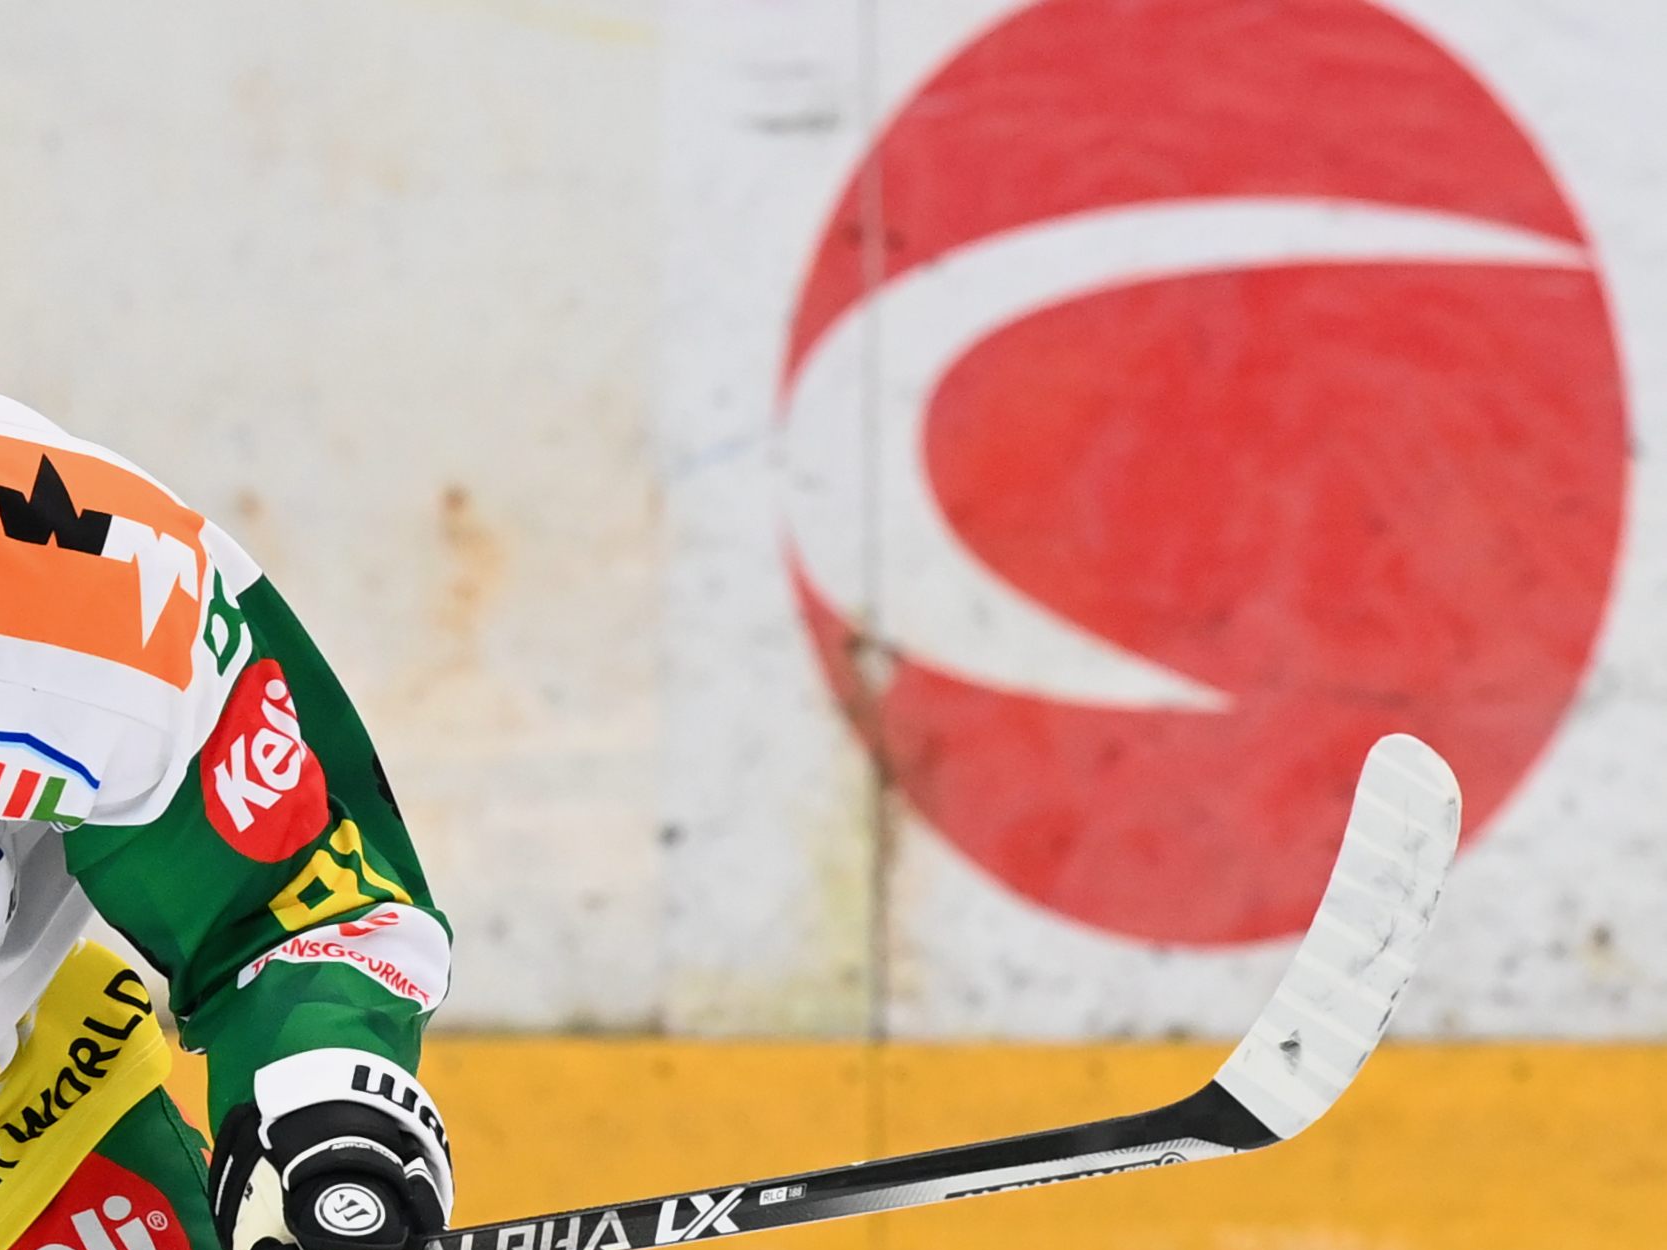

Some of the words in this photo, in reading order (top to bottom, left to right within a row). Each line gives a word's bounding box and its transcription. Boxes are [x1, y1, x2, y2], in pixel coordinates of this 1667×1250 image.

[252, 938, 431, 1005] TNSGOURMET
[655, 1187, 745, 1245] LX
[763, 1190, 784, 1202] RLC
